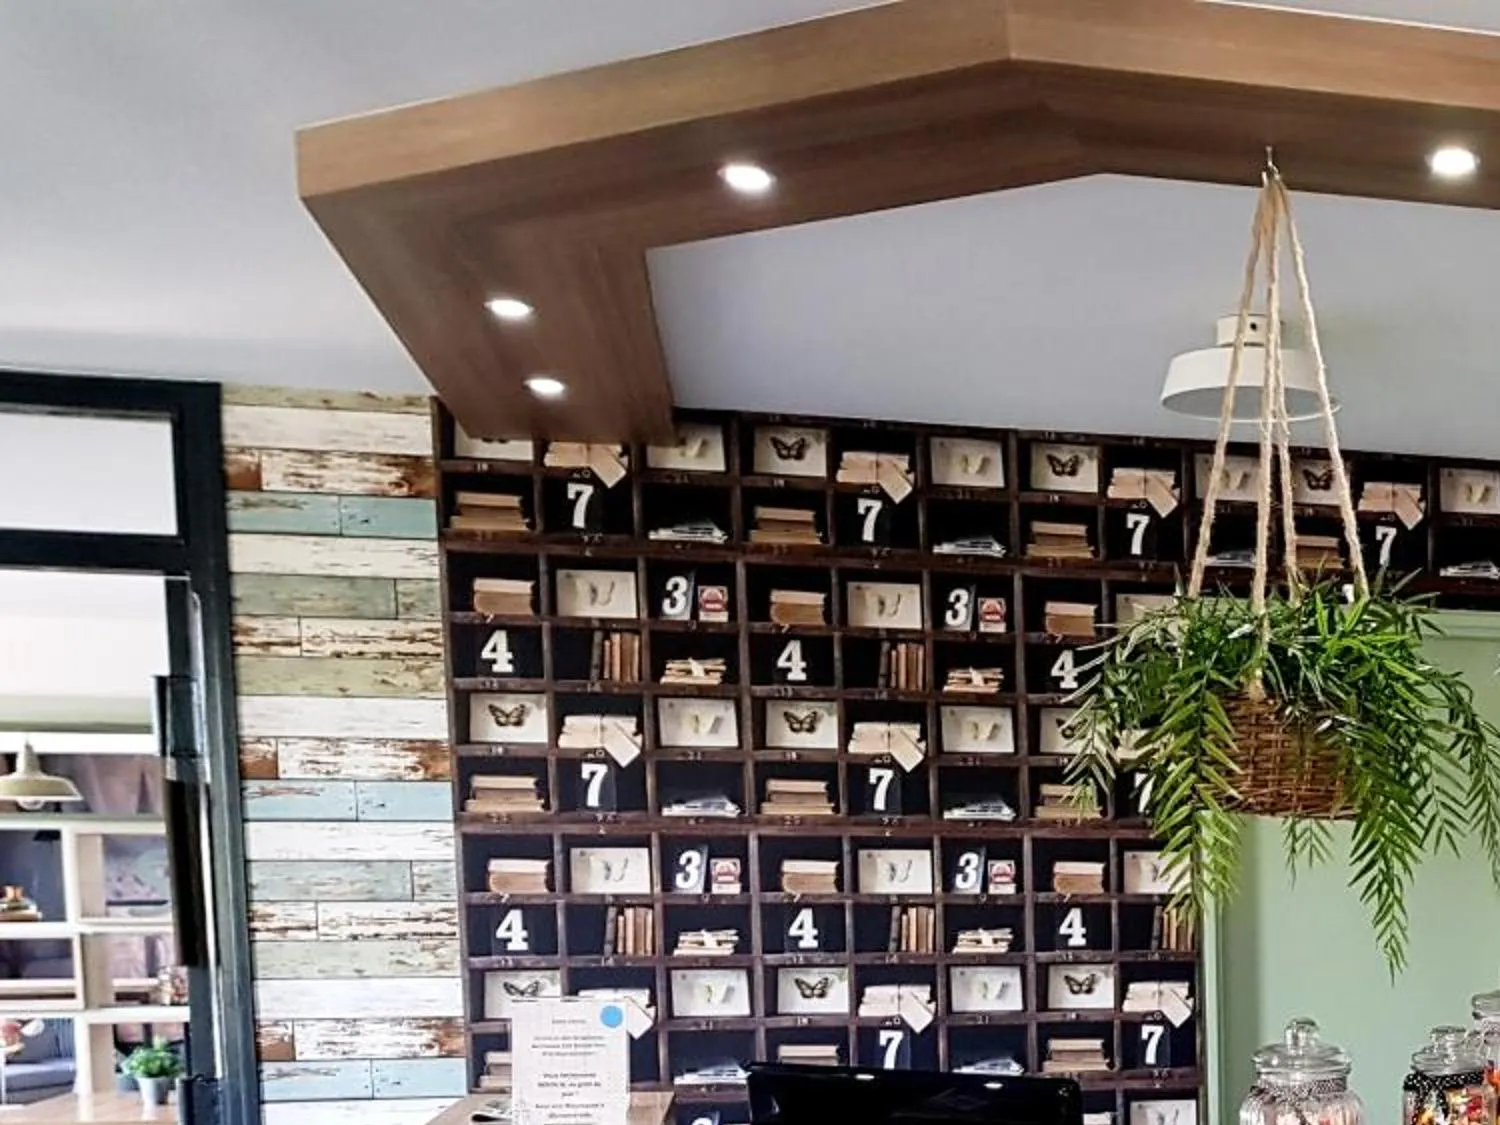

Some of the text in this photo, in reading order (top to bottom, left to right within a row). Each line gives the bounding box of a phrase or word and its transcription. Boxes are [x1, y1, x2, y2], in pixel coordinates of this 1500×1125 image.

[567, 483, 594, 529] 7
[857, 498, 882, 542] 7
[1127, 513, 1150, 555] 7
[1375, 525, 1397, 569] 7
[662, 576, 688, 615] 3
[946, 588, 969, 627] 3
[481, 630, 514, 673] 4
[777, 640, 807, 681] 4
[1051, 650, 1078, 689] 4
[581, 762, 609, 808] 7
[869, 767, 894, 811] 7
[676, 850, 701, 889] 3
[956, 852, 979, 889] 3
[495, 909, 529, 951] 4
[788, 908, 819, 949] 4
[1058, 908, 1087, 947] 4
[879, 1029, 904, 1070] 7
[1141, 1024, 1164, 1065] 7
